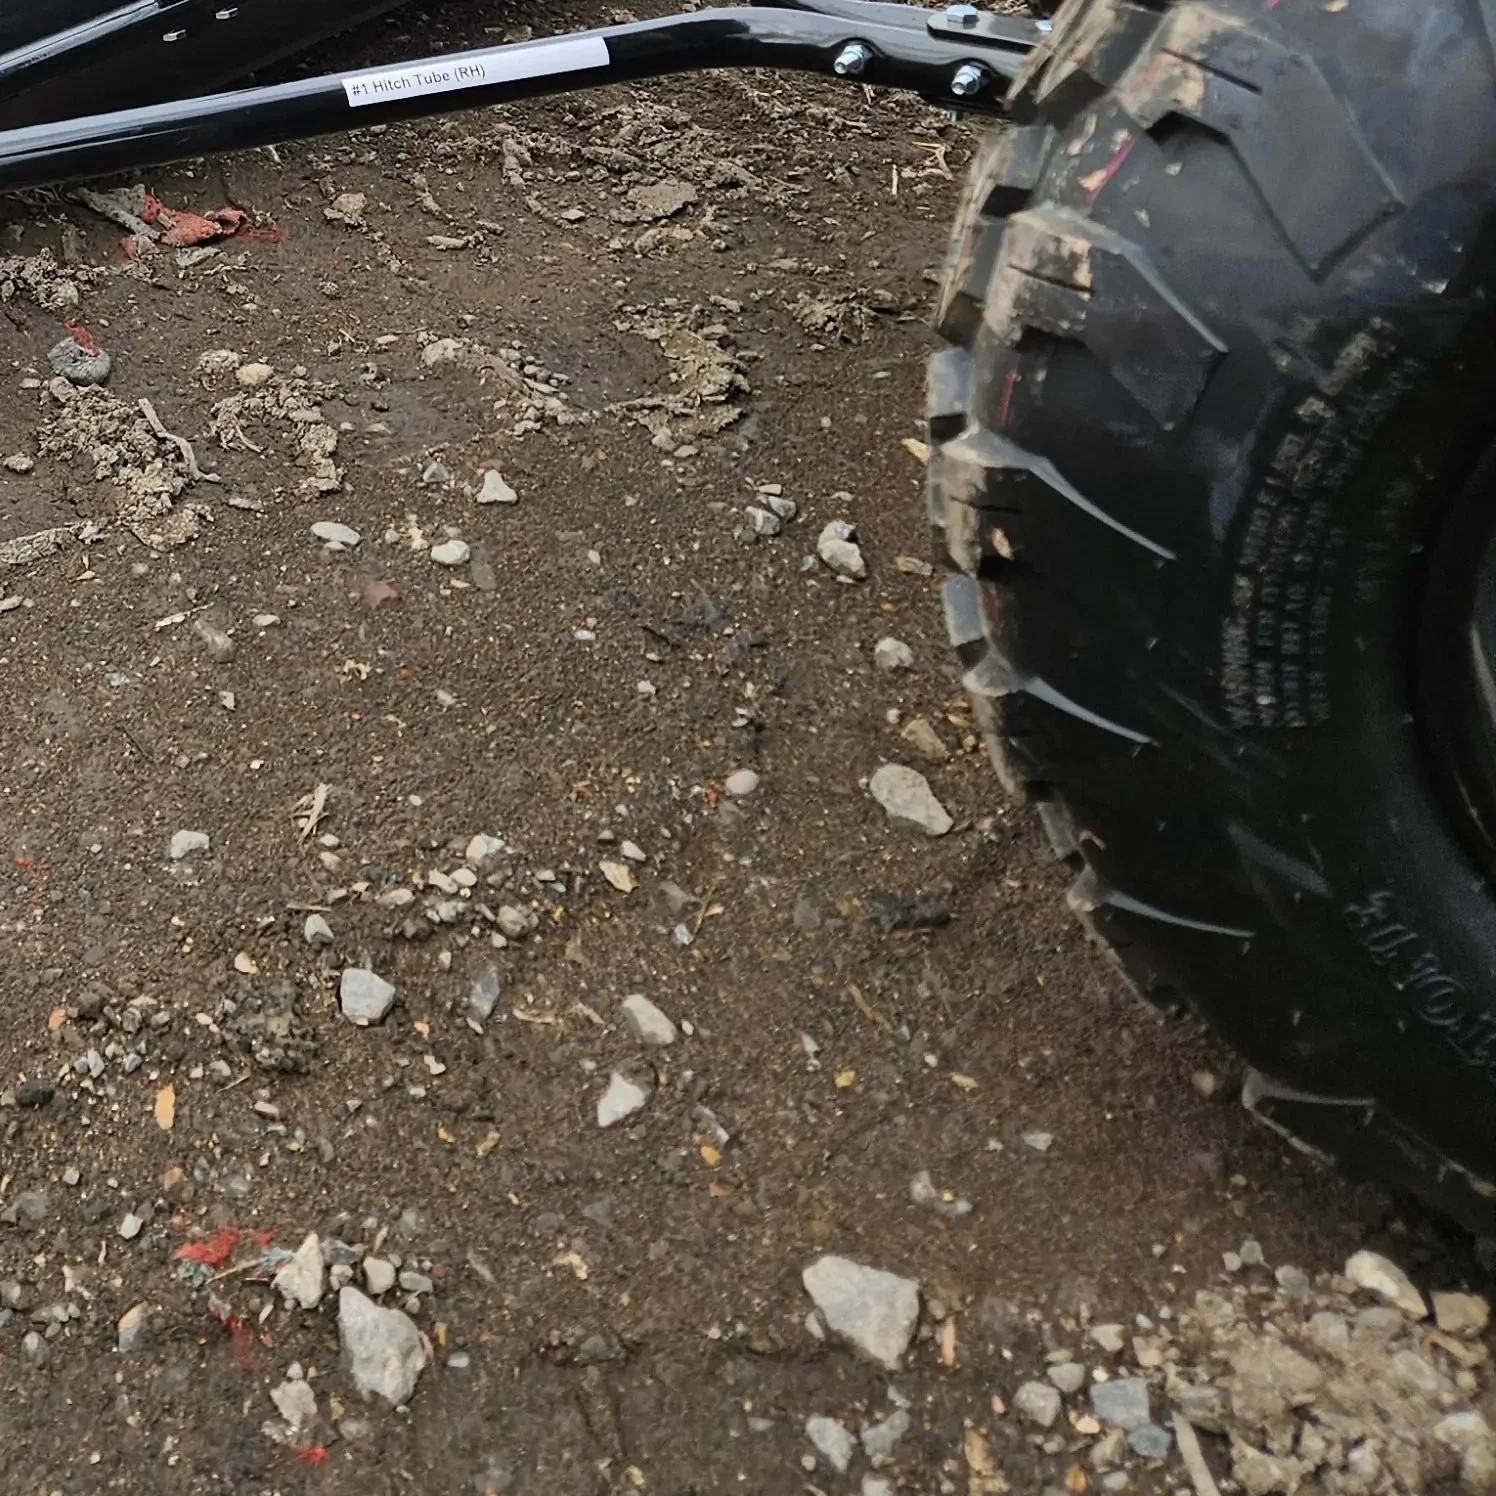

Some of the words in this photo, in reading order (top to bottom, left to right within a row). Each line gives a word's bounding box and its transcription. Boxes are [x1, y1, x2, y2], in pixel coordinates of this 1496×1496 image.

[351, 83, 369, 97] #1
[373, 75, 412, 93] Hitch
[414, 68, 450, 86] Tube
[454, 63, 487, 82] (RH)
